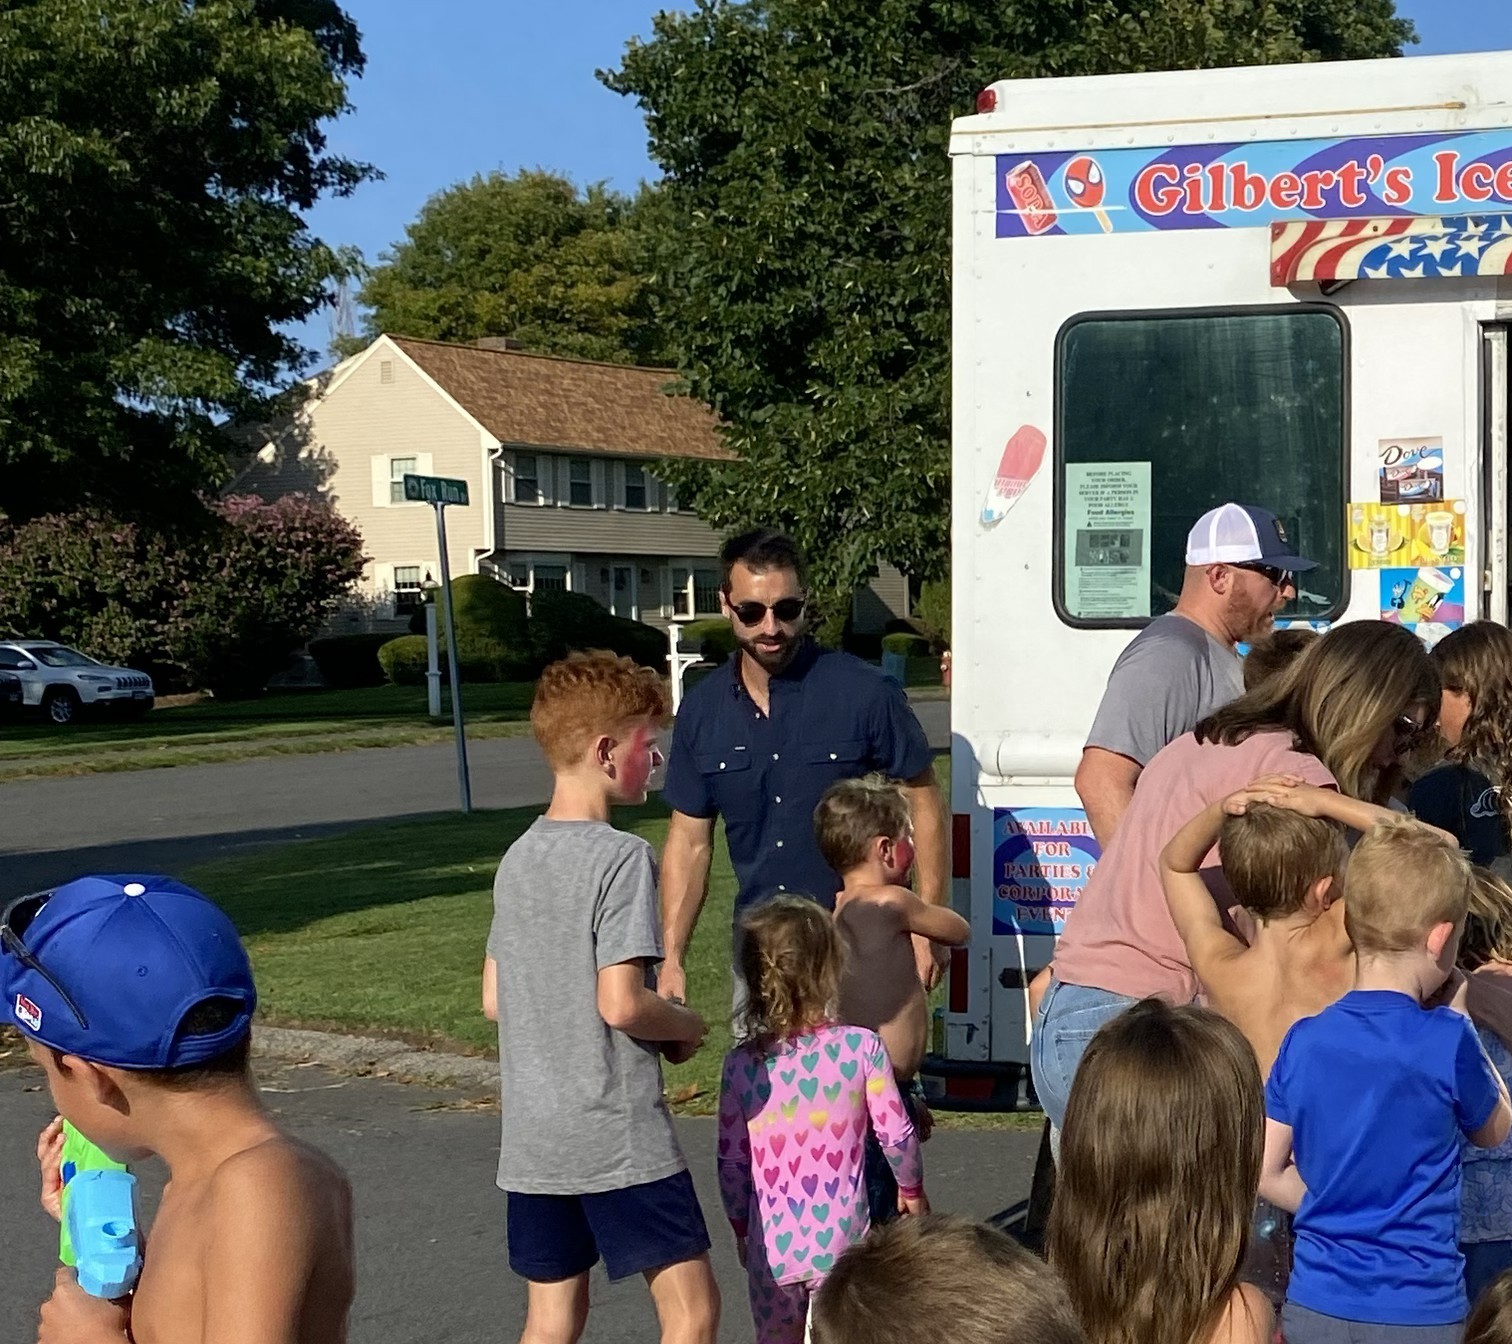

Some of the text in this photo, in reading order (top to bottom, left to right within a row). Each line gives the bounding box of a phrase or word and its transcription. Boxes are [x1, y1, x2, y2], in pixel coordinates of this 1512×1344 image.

[1134, 153, 1413, 217] Gilbert's
[1379, 445, 1433, 465] Dove
[1033, 842, 1071, 857] FOR
[1004, 863, 1081, 879] PARTIES
